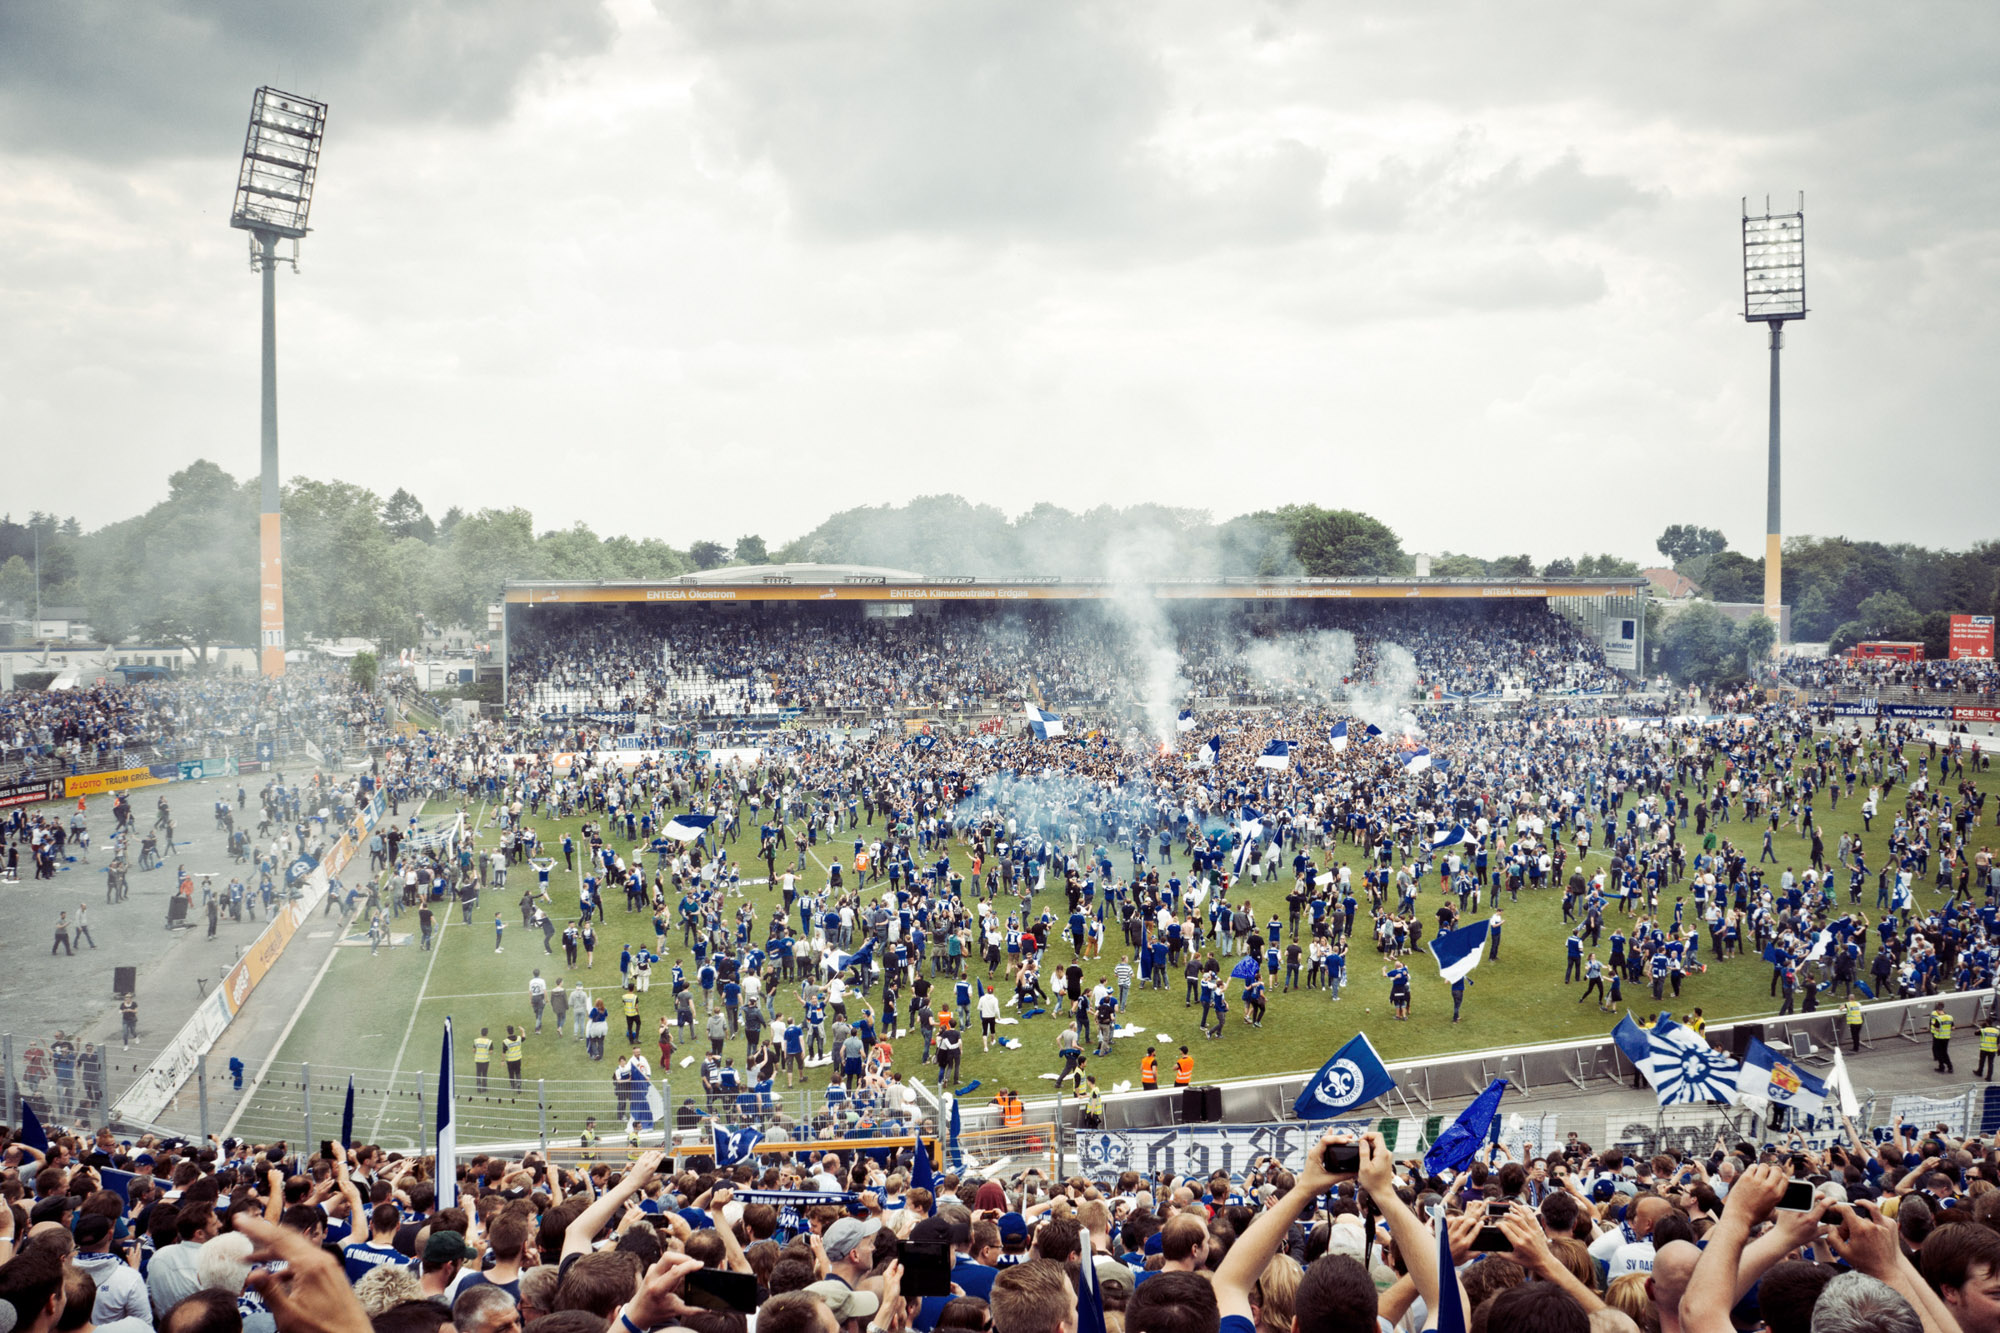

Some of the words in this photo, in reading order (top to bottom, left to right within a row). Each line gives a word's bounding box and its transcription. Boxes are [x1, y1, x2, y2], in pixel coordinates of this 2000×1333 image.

[646, 590, 687, 599] ENTEGA
[688, 588, 736, 599] Ökostrom
[890, 589, 928, 598] ENTEGA
[929, 589, 996, 598] Klimaneutrales
[997, 588, 1029, 599] Erdgas
[1256, 588, 1288, 596] ENTEGA
[1290, 588, 1352, 598] Energieeffizienz
[1482, 588, 1512, 596] ENTEGA
[1512, 587, 1547, 596] Ökostrom
[1845, 705, 1866, 715] sind
[1955, 708, 1975, 717] PCE
[1976, 710, 1995, 718] NET
[79, 779, 102, 790] LOTTO
[104, 773, 129, 786] TRÄUM
[17, 783, 47, 794] WELLNESS
[531, 984, 541, 994] 23
[346, 1247, 355, 1259] SV
[353, 1248, 388, 1265] DARMSTADT
[1626, 1258, 1637, 1270] SV
